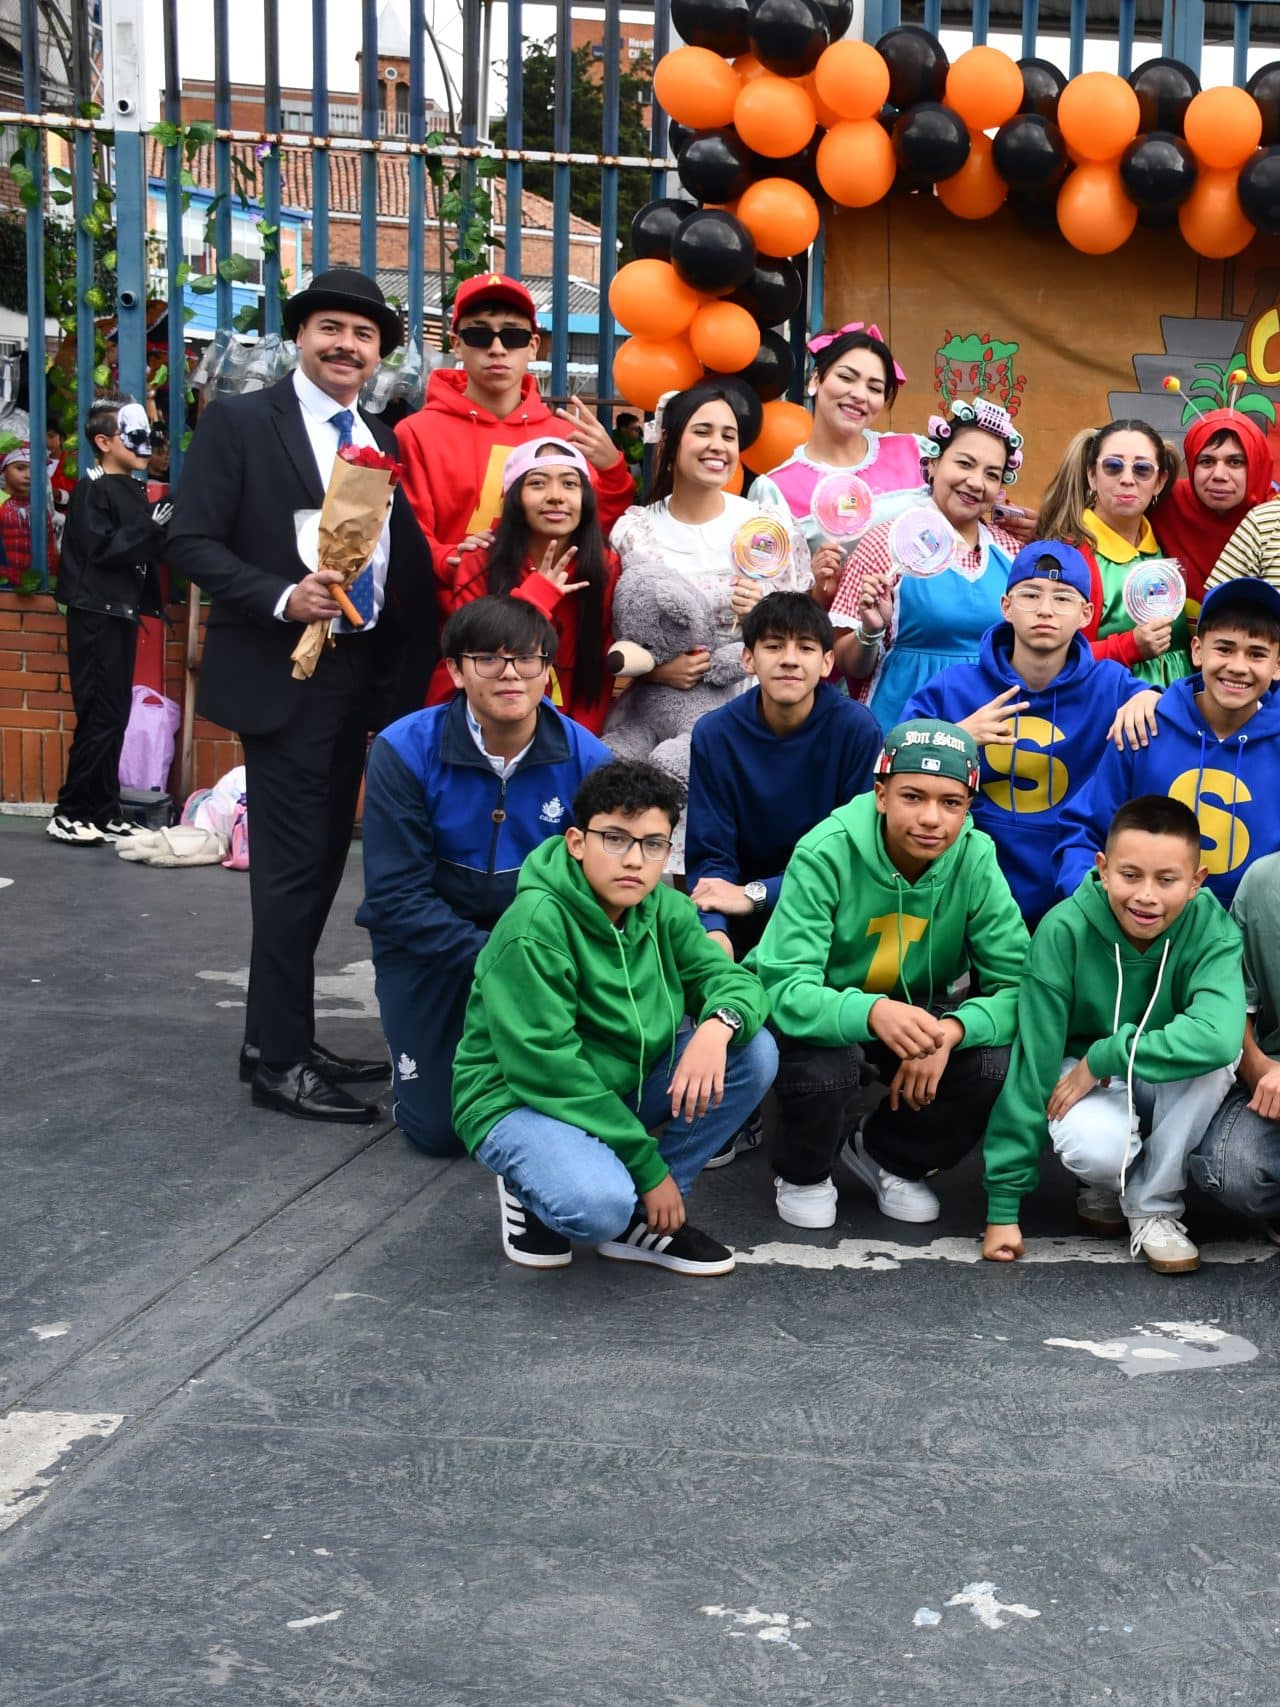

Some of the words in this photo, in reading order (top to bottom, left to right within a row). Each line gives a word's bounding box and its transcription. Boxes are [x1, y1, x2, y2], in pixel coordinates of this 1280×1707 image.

[488, 275, 502, 285] A
[982, 716, 1069, 814] S
[1168, 768, 1253, 875] S
[863, 912, 930, 995] T
